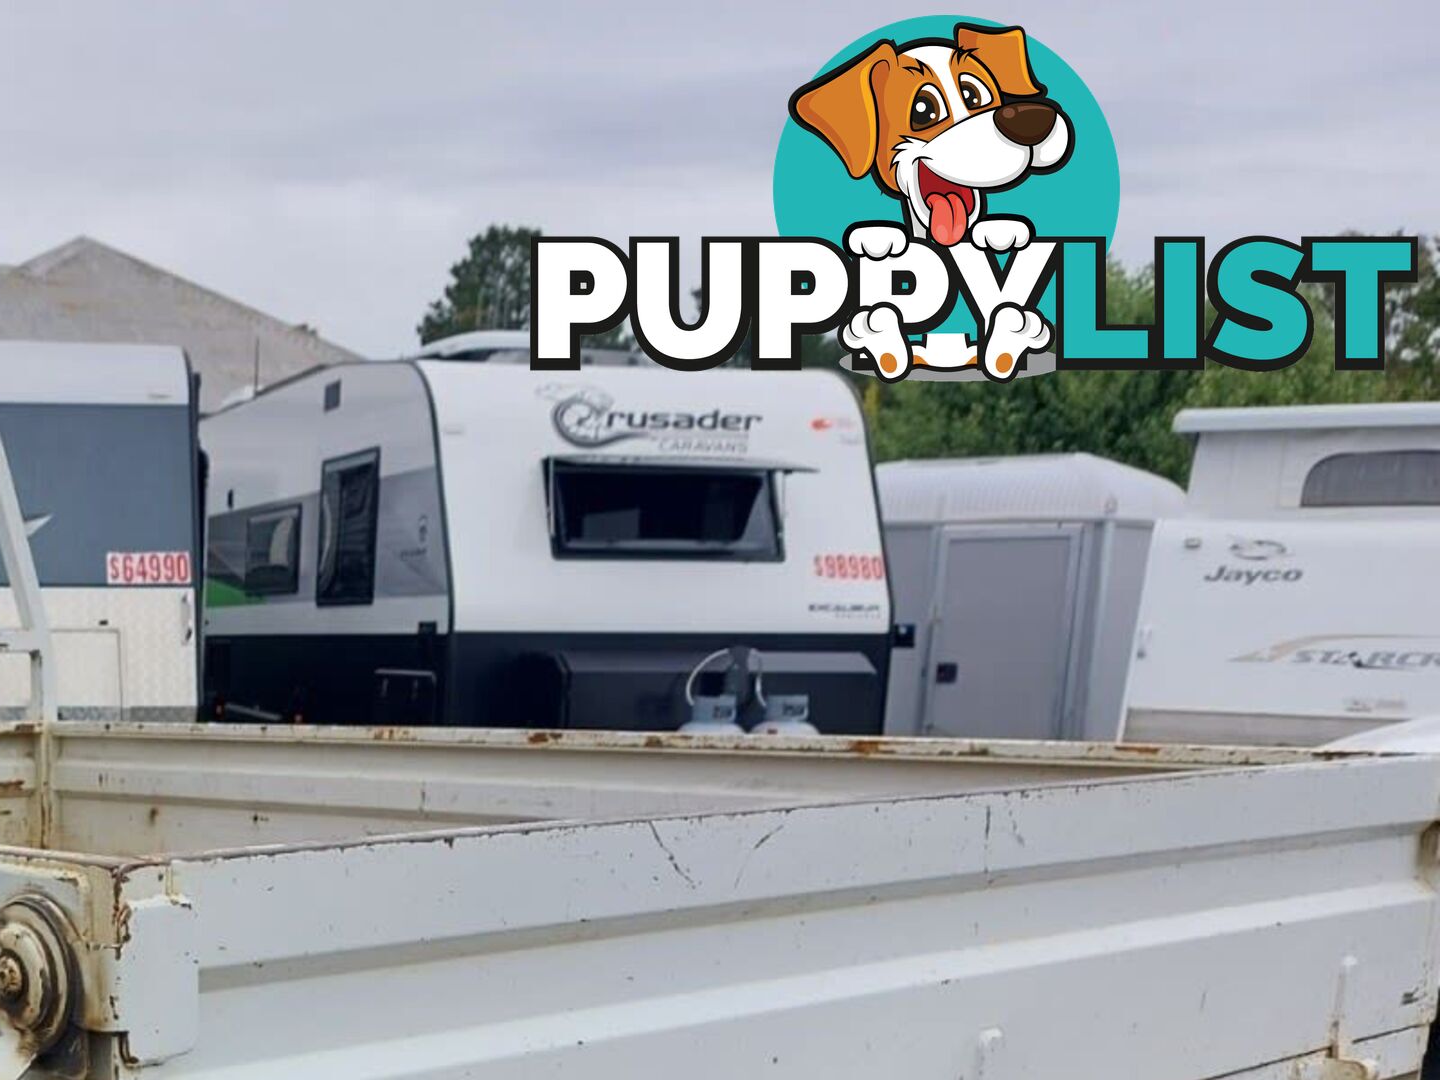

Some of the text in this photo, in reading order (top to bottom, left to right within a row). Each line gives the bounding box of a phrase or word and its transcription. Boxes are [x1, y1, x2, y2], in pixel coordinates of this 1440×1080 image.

[551, 394, 764, 449] Crusader
[109, 553, 189, 582] $64990
[1203, 565, 1304, 586] Jayco
